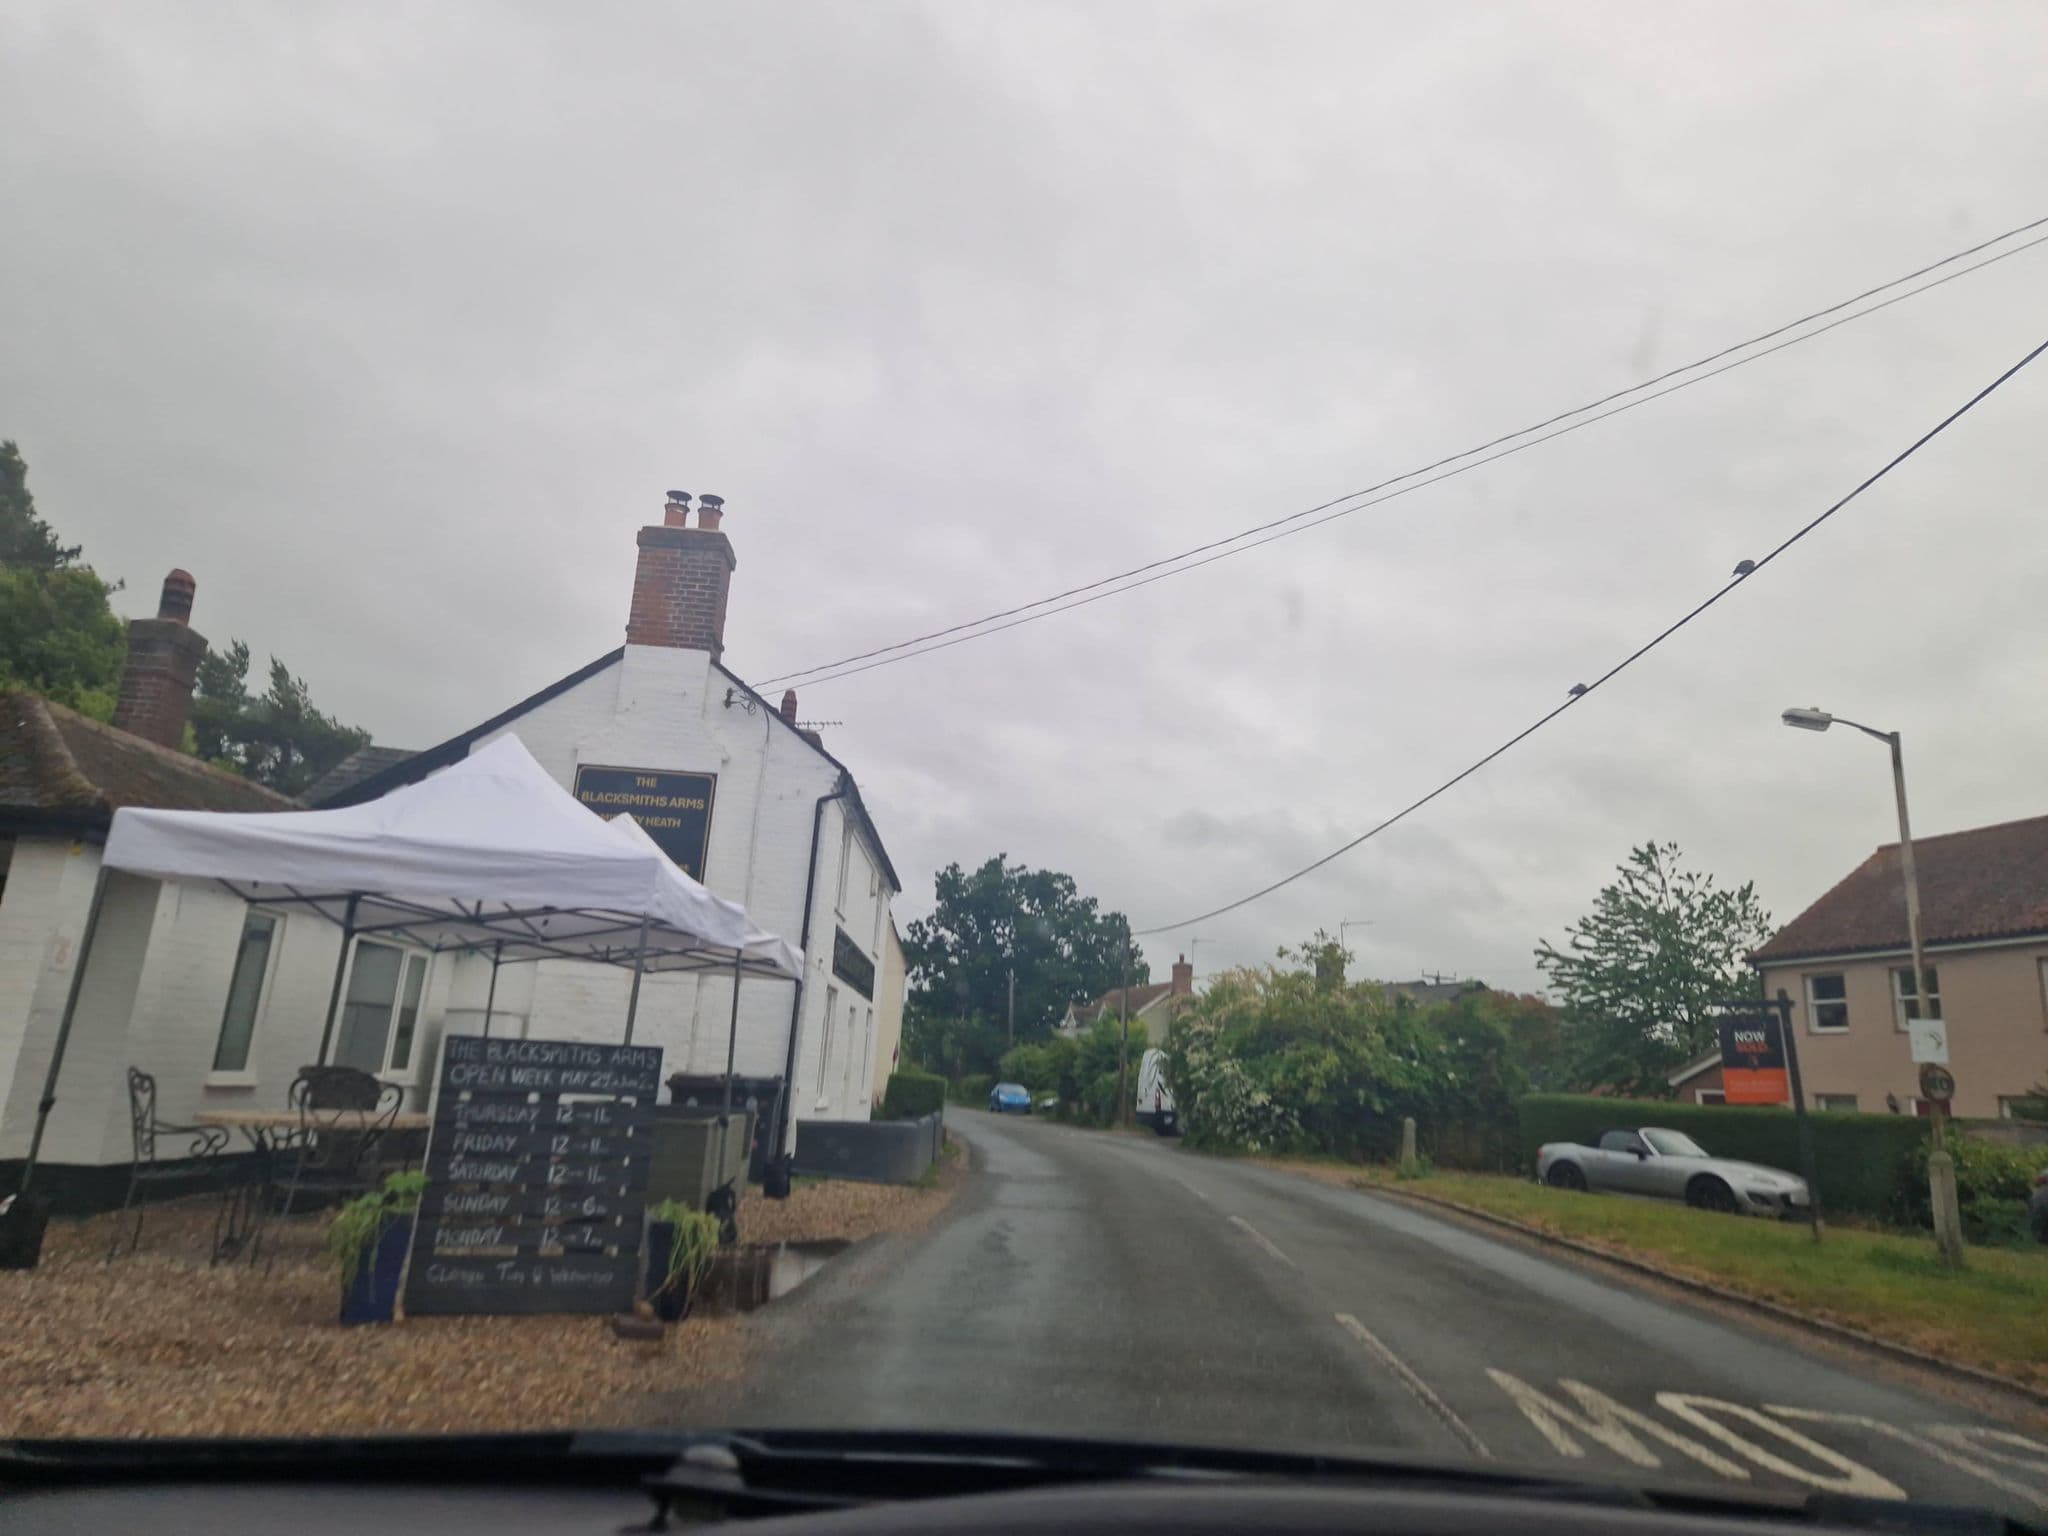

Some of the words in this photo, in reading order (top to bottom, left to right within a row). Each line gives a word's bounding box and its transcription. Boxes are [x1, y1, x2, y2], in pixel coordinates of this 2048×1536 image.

[635, 776, 657, 788] THE
[581, 790, 668, 807] BLACKSMITHS
[669, 797, 705, 810] ARMS
[645, 816, 681, 828] HEATH
[1734, 1031, 1766, 1042] NOW
[449, 1039, 481, 1060] THE
[487, 1041, 601, 1066] BLACKSMITHS
[611, 1047, 658, 1070] ARMS
[449, 1064, 507, 1086] OPEN
[511, 1067, 553, 1087] WEEK
[454, 1103, 541, 1123] THURSDAY
[556, 1104, 574, 1123] 12
[452, 1133, 518, 1153] FRIDAY
[551, 1135, 570, 1154] 12
[448, 1162, 519, 1183] SATURDAY
[547, 1163, 568, 1184] 12
[443, 1193, 511, 1214] SUNDAY
[543, 1196, 561, 1216] 12
[435, 1226, 505, 1248] MONDAY
[541, 1226, 560, 1248] 12
